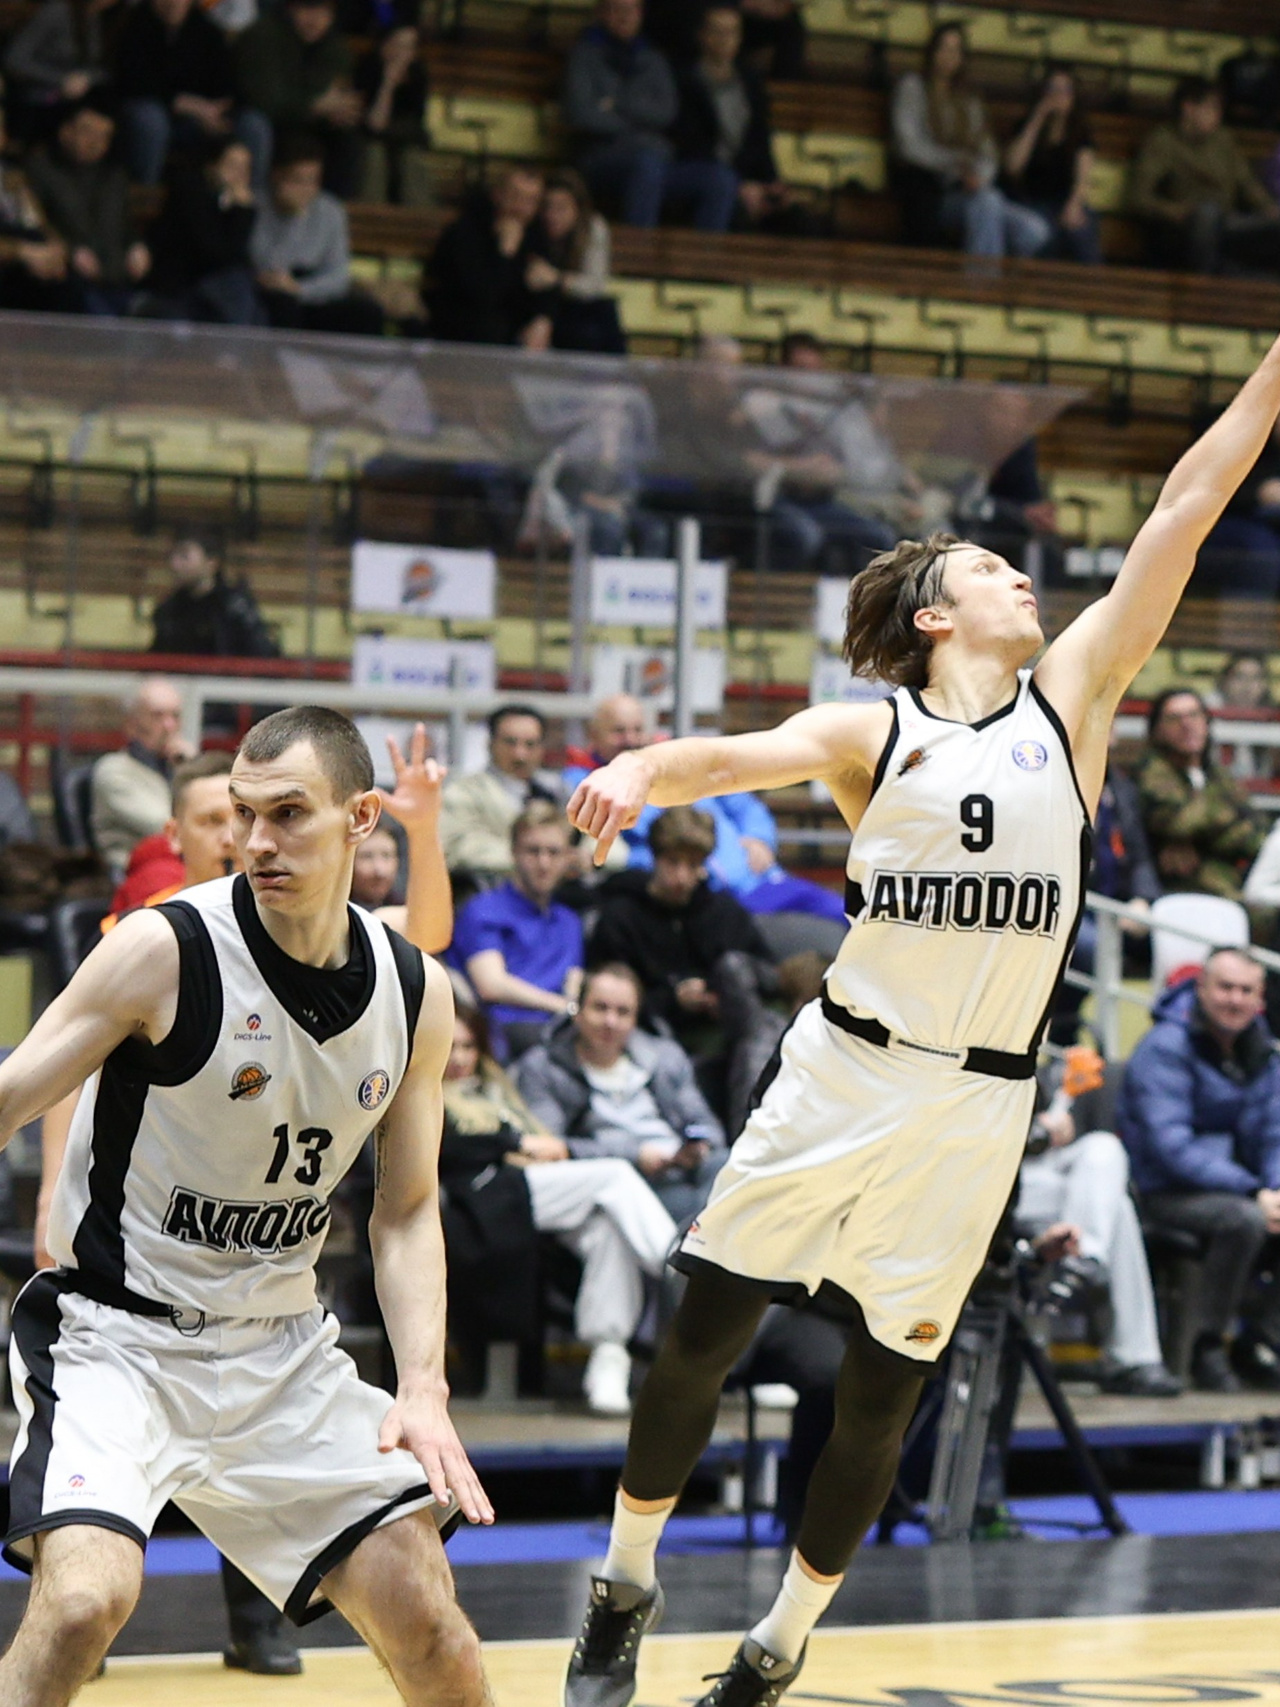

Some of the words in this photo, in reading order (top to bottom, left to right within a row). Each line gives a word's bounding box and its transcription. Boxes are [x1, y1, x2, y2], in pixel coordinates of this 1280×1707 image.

[960, 793, 994, 853] 9
[863, 869, 1061, 941] AVTODOR
[264, 1122, 334, 1186] 13
